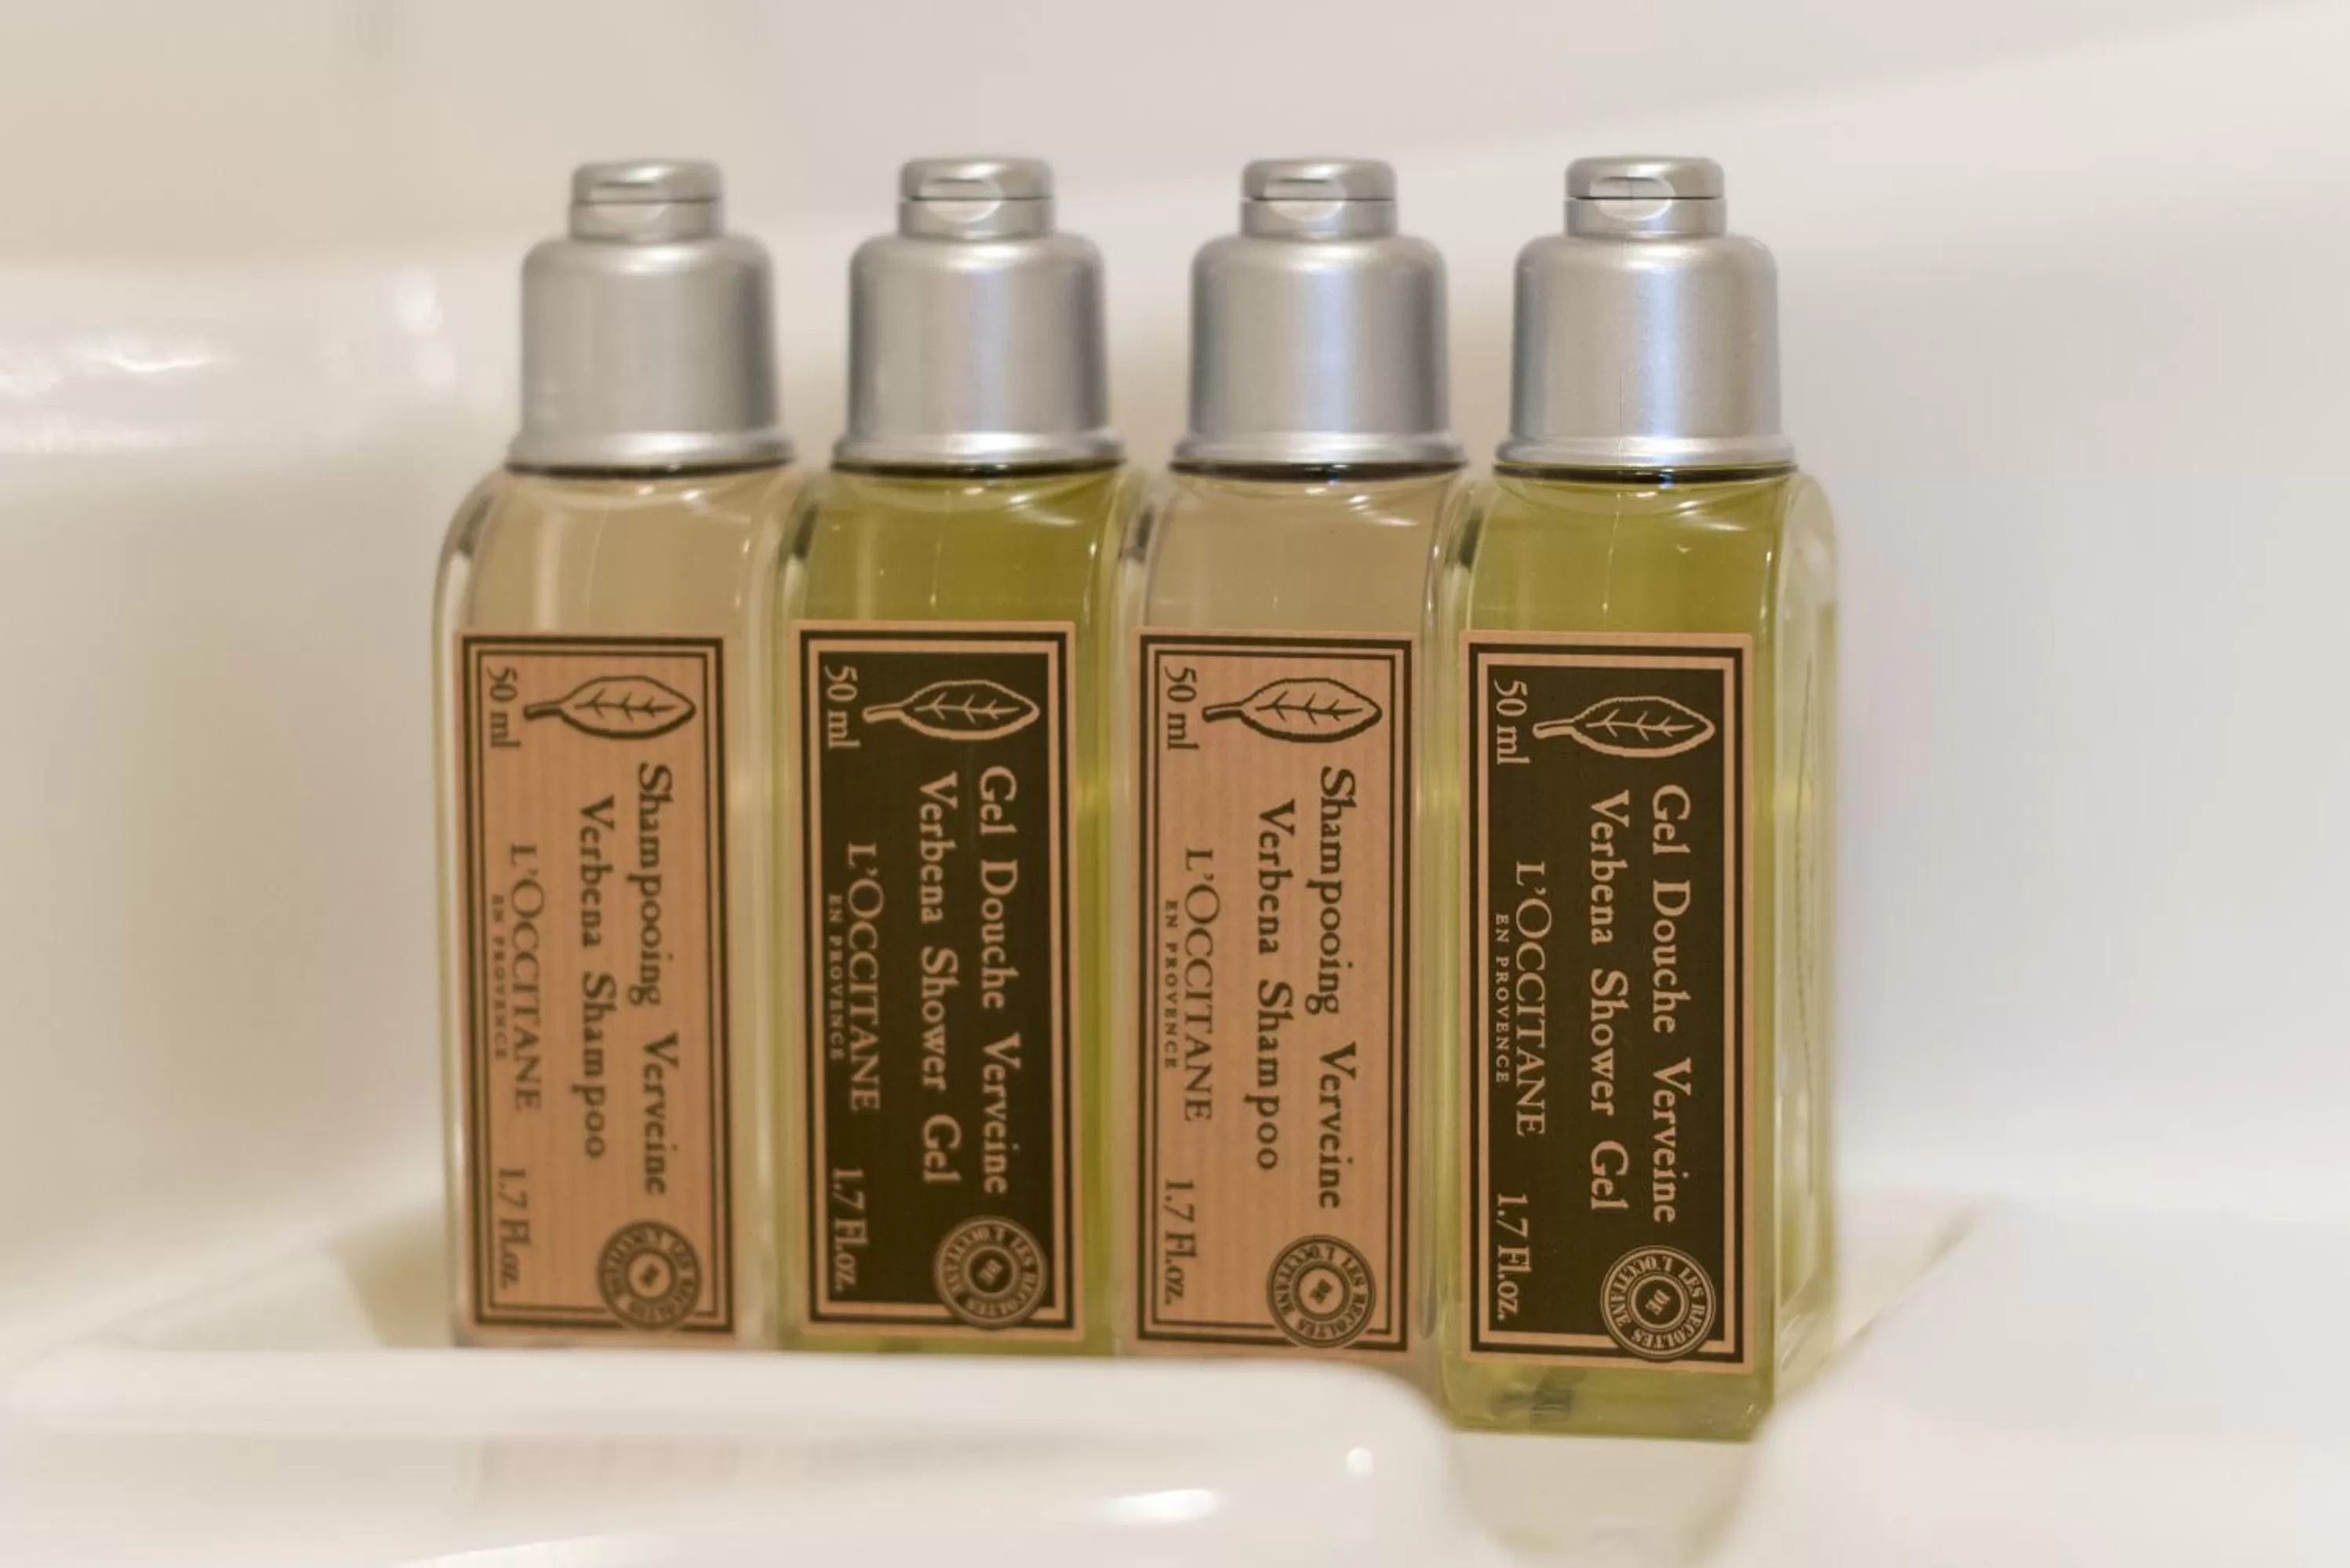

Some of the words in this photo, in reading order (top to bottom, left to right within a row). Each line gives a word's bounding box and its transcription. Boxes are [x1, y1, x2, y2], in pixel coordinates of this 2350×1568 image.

[486, 667, 518, 704] 50
[489, 711, 522, 749] ml
[824, 665, 858, 702] 50
[828, 710, 861, 749] ml
[1165, 667, 1198, 704] 50
[1166, 711, 1200, 751] ml
[1493, 680, 1528, 717] 50
[1496, 724, 1531, 765] ml
[919, 771, 959, 924] Verbena
[979, 766, 1017, 835] Gel
[1652, 784, 1691, 854] Gel
[580, 795, 616, 948] Verbena
[625, 762, 674, 1006] Shampooing
[828, 894, 842, 922] EN
[1165, 900, 1179, 928] EN
[1257, 798, 1296, 955] Verbena
[1304, 766, 1358, 1016] Shampooing
[1495, 914, 1510, 943] EN
[1590, 789, 1630, 945] Verbena
[510, 844, 545, 1111] L'OCCITANE
[847, 842, 884, 1111] L'OCCITANE
[980, 859, 1019, 1009] Douche
[1184, 849, 1220, 1122] L'OCCITANE
[1652, 879, 1691, 1033] Douche
[828, 935, 845, 1060] PROVENCE
[920, 946, 959, 1091] Shower
[1164, 942, 1178, 1068] PROVENCE
[1495, 956, 1510, 1082] PROVENCE
[1515, 860, 1552, 1137] L'OCCITANE
[1590, 968, 1630, 1116] Shower
[570, 971, 617, 1159] Shampoo
[642, 1031, 679, 1195] Verveine
[982, 1031, 1021, 1194] Verveine
[1242, 978, 1295, 1171] Shampoo
[1318, 1041, 1357, 1209] Verveine
[832, 1168, 865, 1210] 1.7
[922, 1114, 962, 1182] Gel
[1163, 1178, 1195, 1224] 1.7
[1590, 1140, 1629, 1210] Gel
[1652, 1057, 1692, 1223] Verveine
[1496, 1193, 1529, 1239] 1.7
[1630, 1303, 1706, 1349] RECOLTES
[1644, 1288, 1672, 1316] DE
[1677, 1266, 1704, 1298] LES
